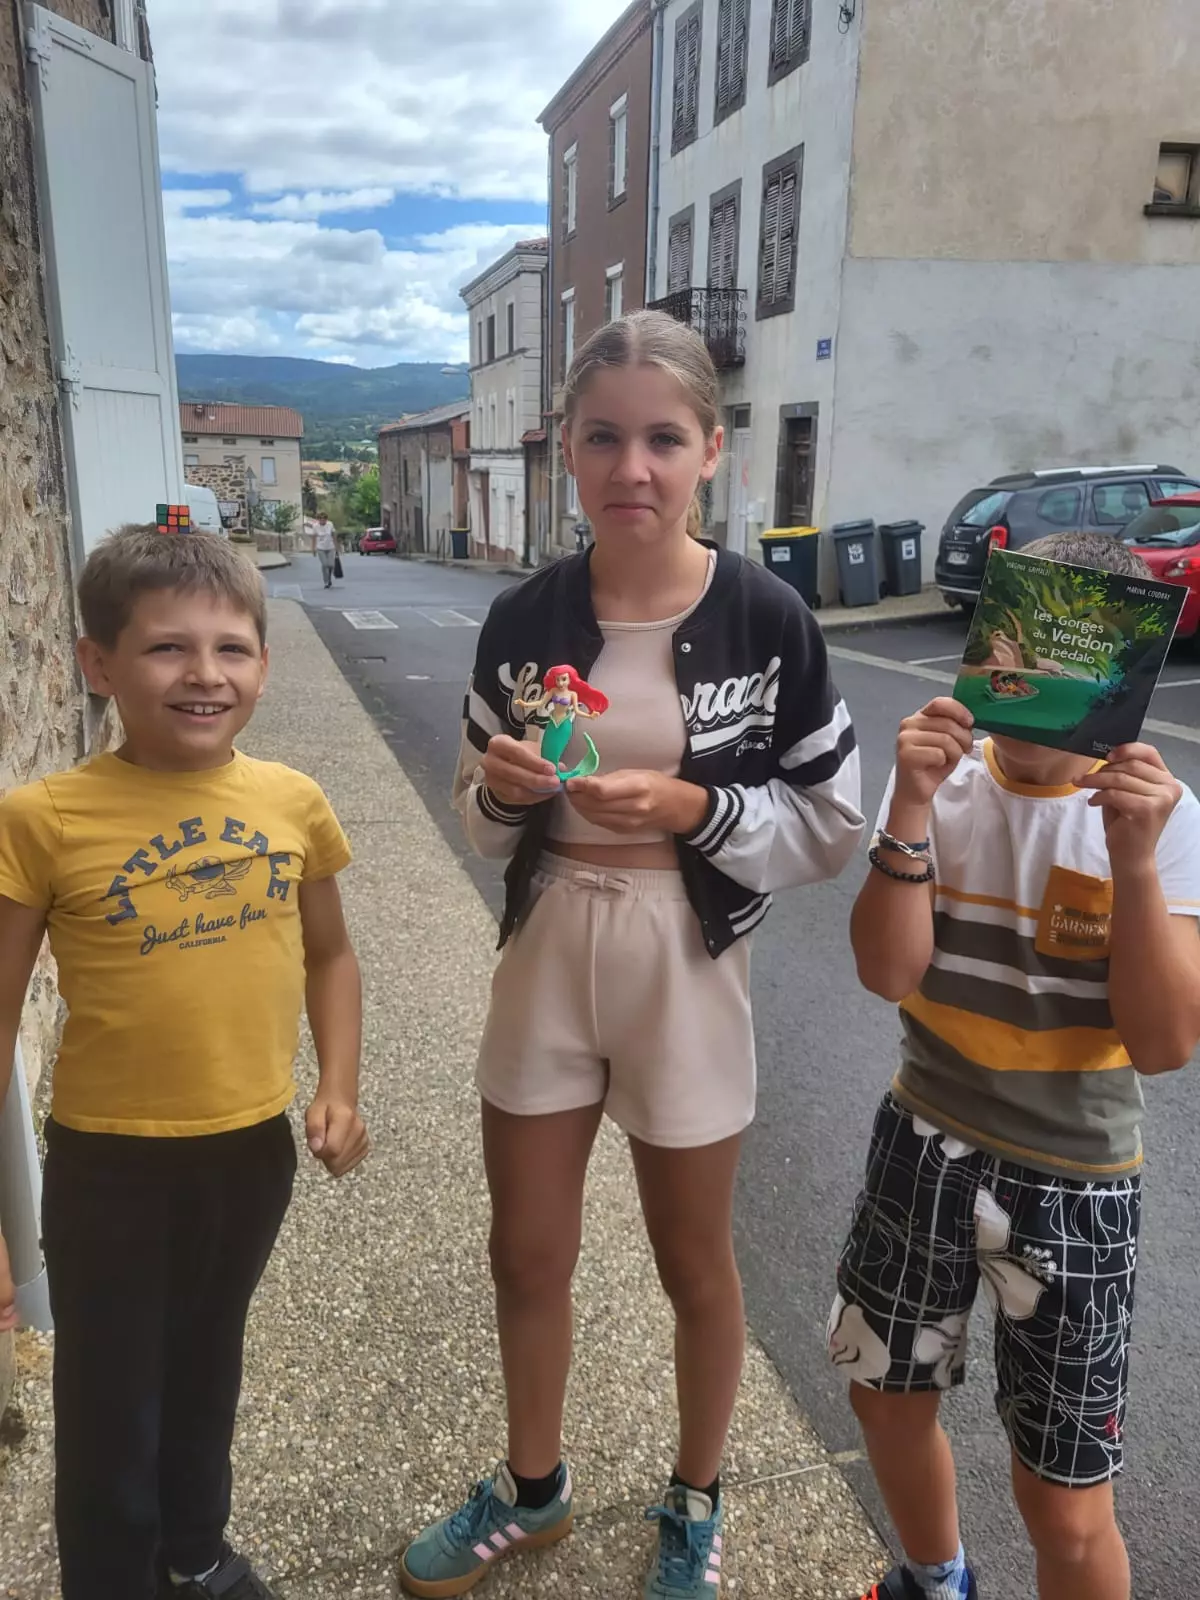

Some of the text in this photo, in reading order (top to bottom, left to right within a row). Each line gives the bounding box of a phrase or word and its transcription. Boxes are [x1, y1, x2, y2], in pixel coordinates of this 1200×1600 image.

[1033, 609, 1105, 634] Les Gorges
[1032, 627, 1114, 655] du Verdon
[1034, 646, 1096, 665] en pédalo
[140, 902, 268, 955] Just have fun
[178, 935, 228, 950] CALIFORNIA
